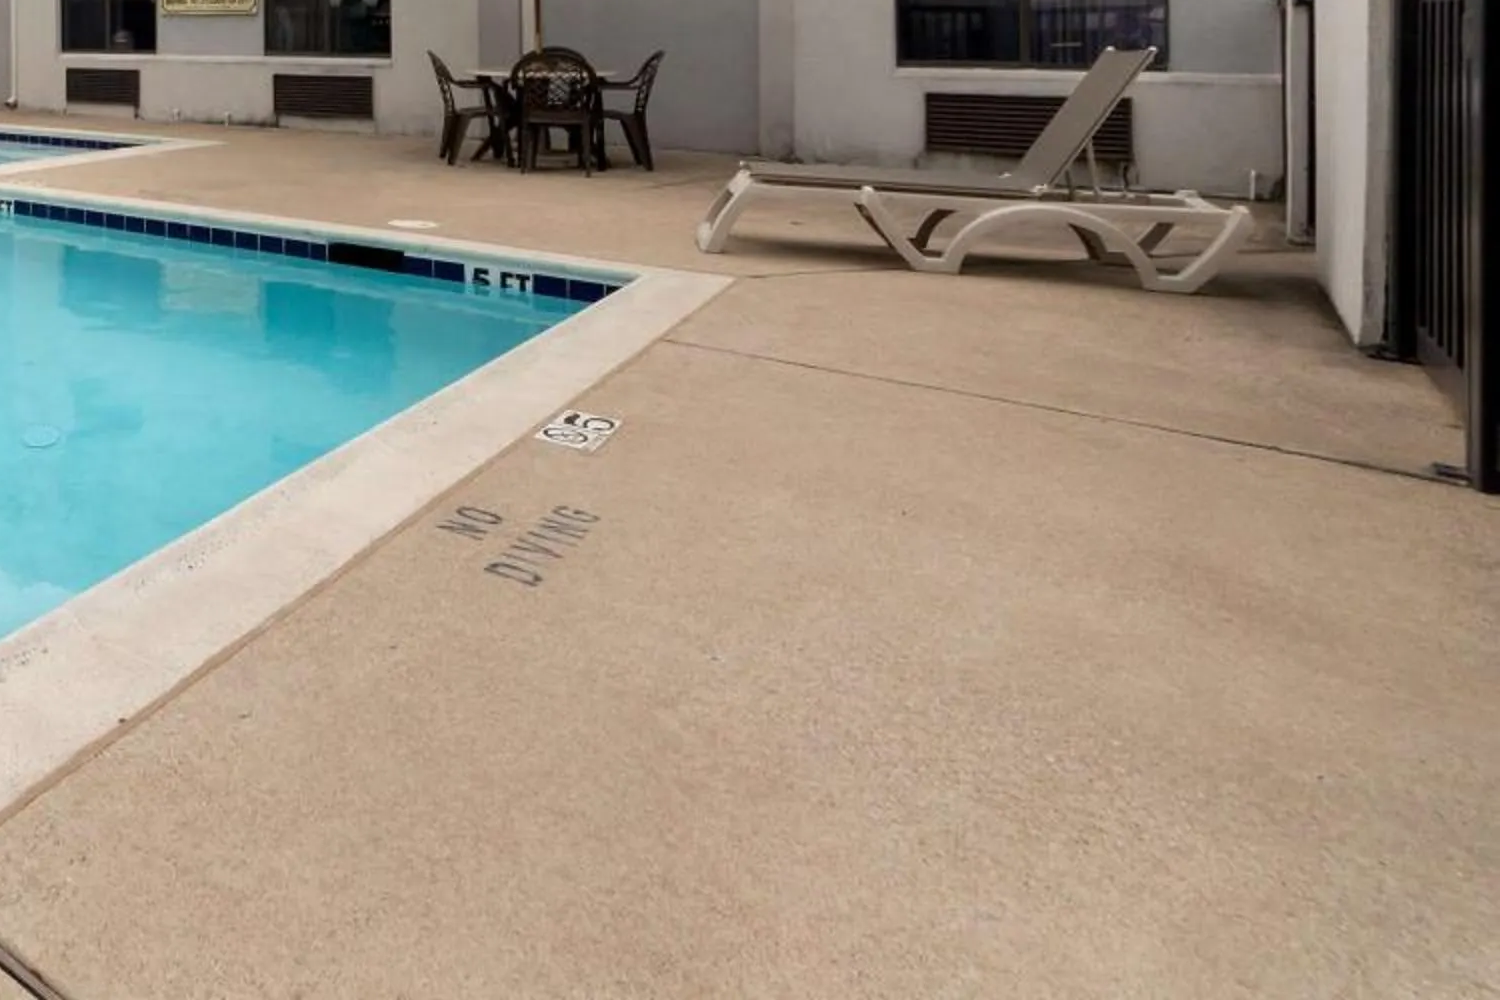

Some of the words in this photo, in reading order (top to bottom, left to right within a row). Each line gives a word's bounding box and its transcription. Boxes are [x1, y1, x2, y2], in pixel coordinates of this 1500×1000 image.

[472, 266, 491, 287] 5
[500, 271, 531, 293] FT
[435, 505, 503, 542] NO
[483, 505, 601, 588] DIVING
